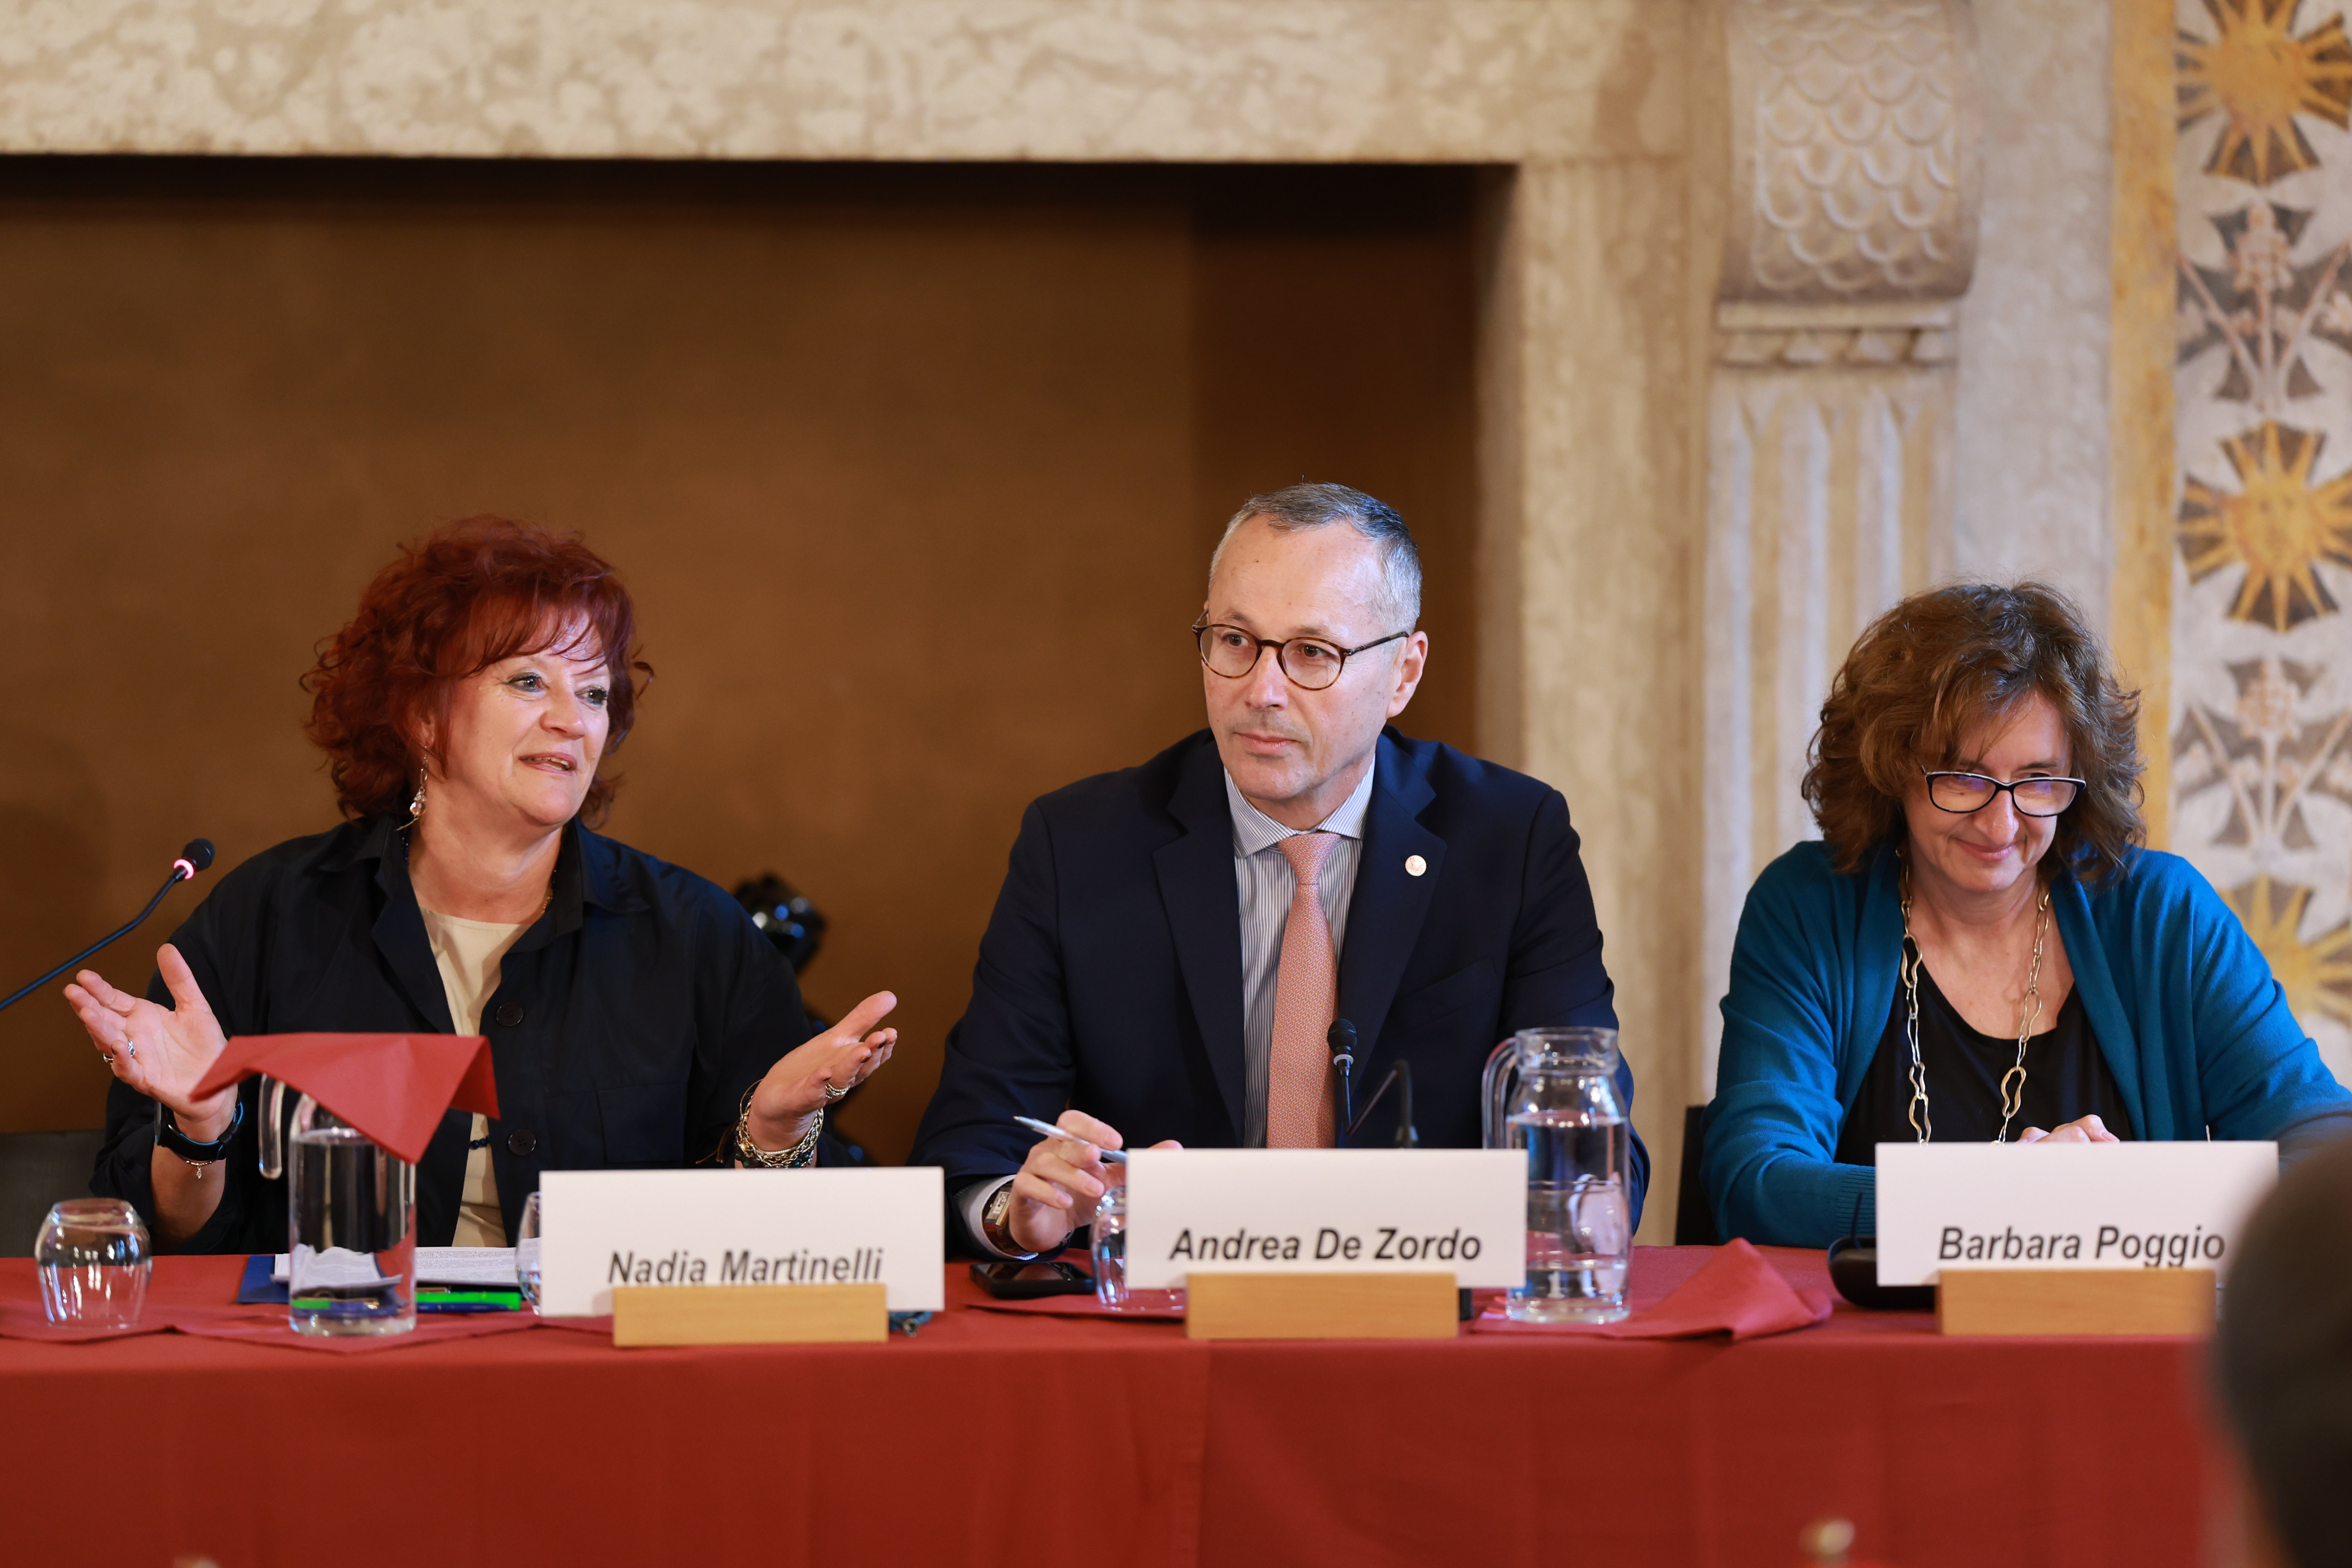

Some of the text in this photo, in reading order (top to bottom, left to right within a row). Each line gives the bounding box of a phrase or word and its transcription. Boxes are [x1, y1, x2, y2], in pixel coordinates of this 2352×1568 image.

[1168, 1227, 1482, 1261] Andrea De Zordo
[1938, 1225, 2226, 1267] Barbara Poggio
[608, 1248, 883, 1283] Nadia Martinelli
